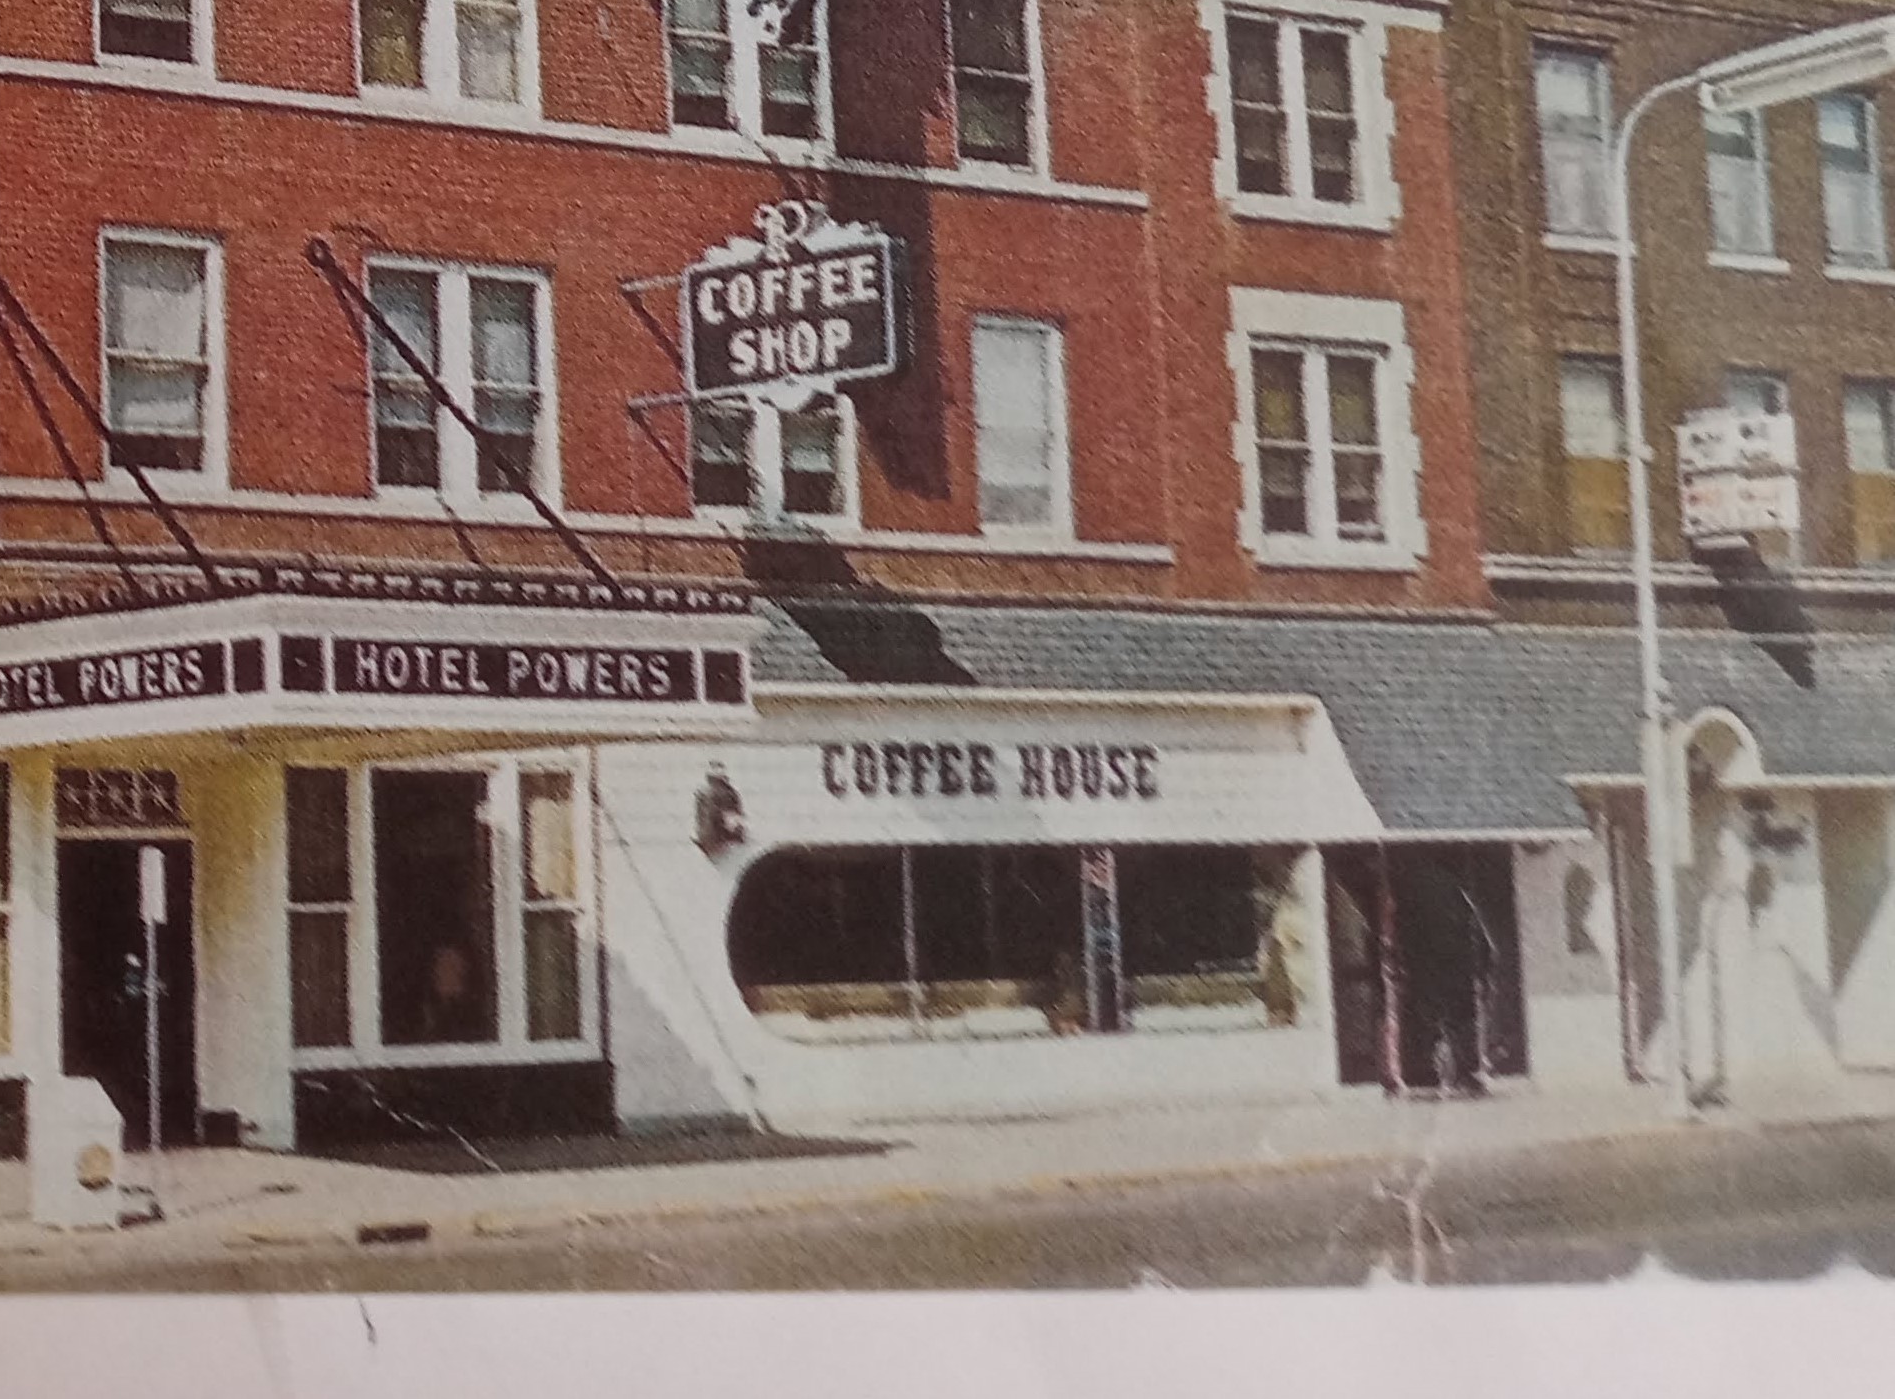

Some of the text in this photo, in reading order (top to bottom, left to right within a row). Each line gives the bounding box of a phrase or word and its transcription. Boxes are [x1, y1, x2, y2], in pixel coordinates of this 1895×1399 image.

[696, 253, 882, 325] COFFEE
[727, 319, 853, 376] SHOP
[78, 649, 205, 701] POWERS
[355, 642, 674, 698] HOTEL POWERS
[820, 740, 1161, 801] COFFEE HOUSE
